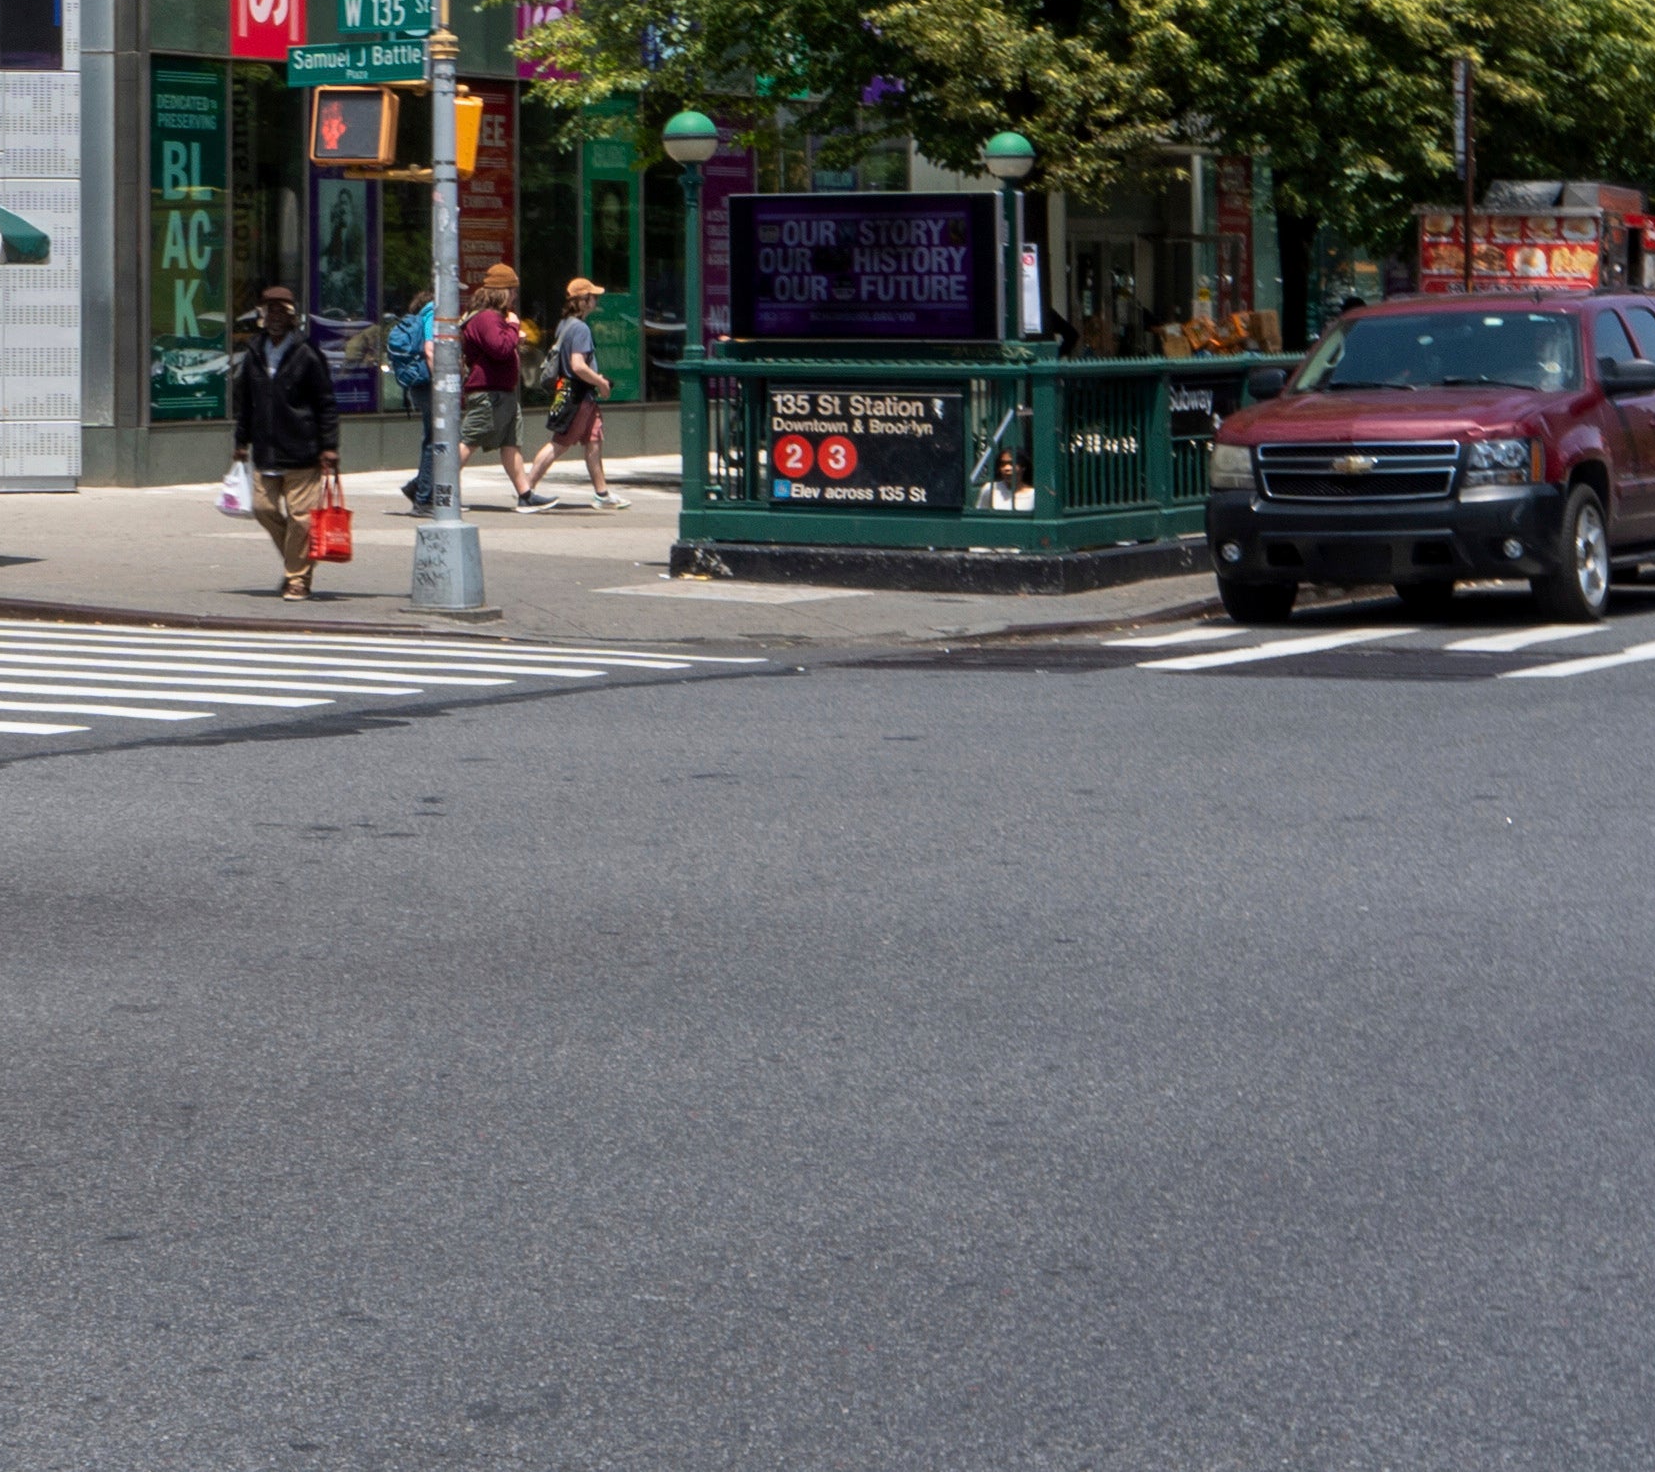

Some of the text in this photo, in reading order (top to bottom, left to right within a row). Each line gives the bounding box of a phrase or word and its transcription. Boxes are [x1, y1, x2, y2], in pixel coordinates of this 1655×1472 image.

[292, 45, 422, 70] Samuel J Battle
[156, 94, 209, 110] DEDICATED
[158, 115, 217, 130] PRESERVING
[162, 140, 212, 201] BL
[162, 209, 212, 270] AC
[783, 220, 945, 247] OUR STORY
[758, 247, 968, 274] OUR HISTORY
[774, 275, 968, 301] OUR FUTURE
[175, 279, 201, 338] K
[772, 394, 925, 417] 135 St Station
[1169, 384, 1214, 415] Subway
[772, 417, 849, 434] Downtown
[852, 419, 865, 435] &
[785, 444, 846, 470] 2 3
[790, 483, 928, 503] Elev across 135 St
